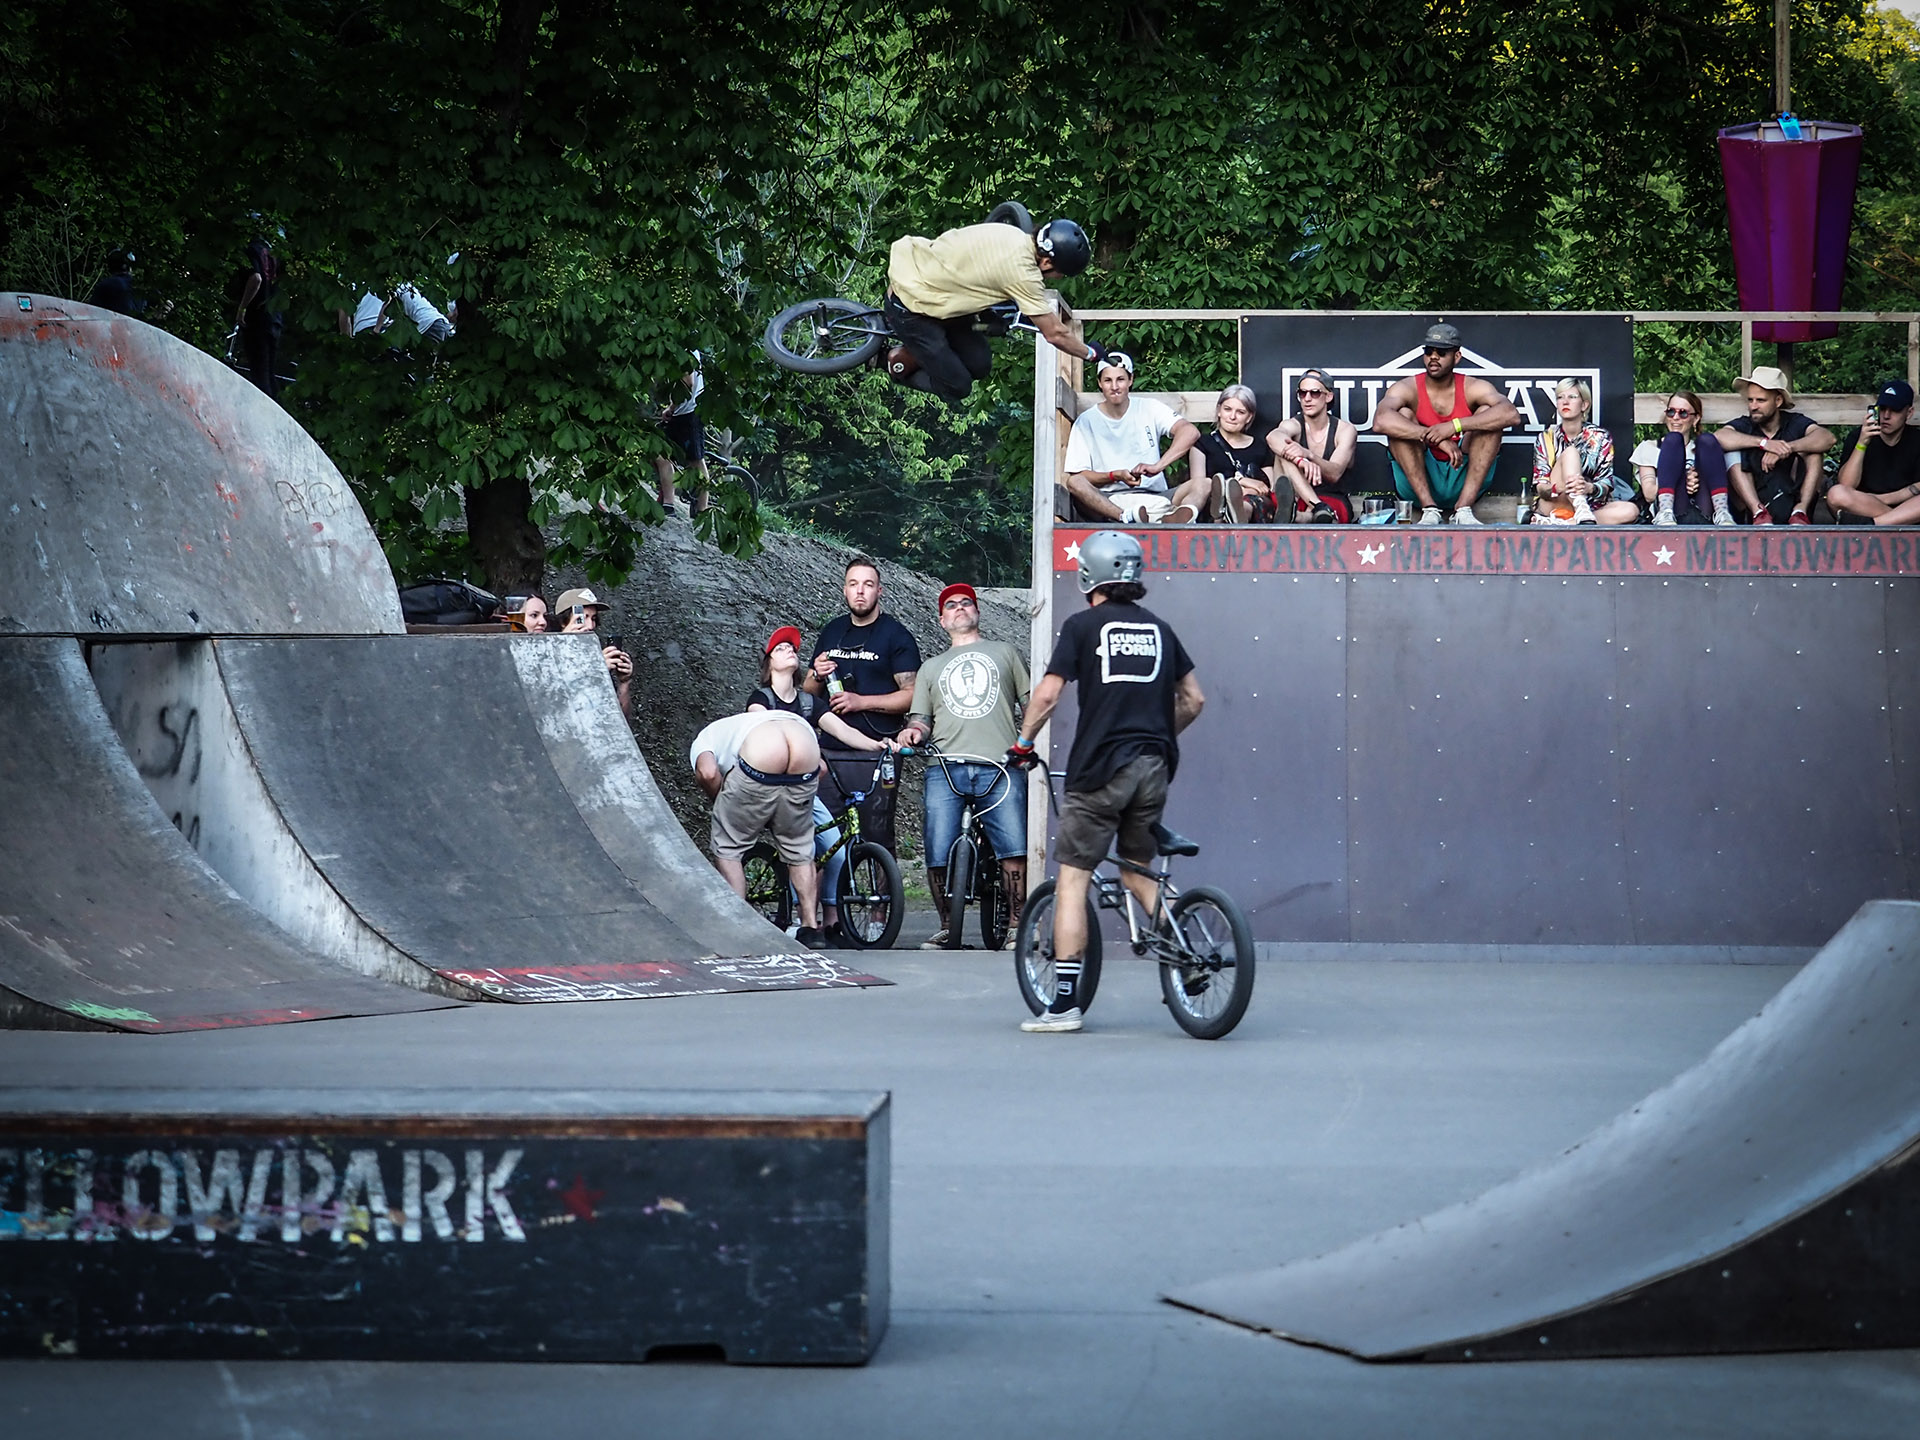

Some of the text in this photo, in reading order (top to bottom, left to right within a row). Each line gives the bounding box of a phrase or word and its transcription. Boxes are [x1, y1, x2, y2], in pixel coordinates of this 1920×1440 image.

[1390, 536, 1642, 571] MELLOWPARK
[1109, 633, 1155, 645] KUNST
[1110, 643, 1157, 657] FORM
